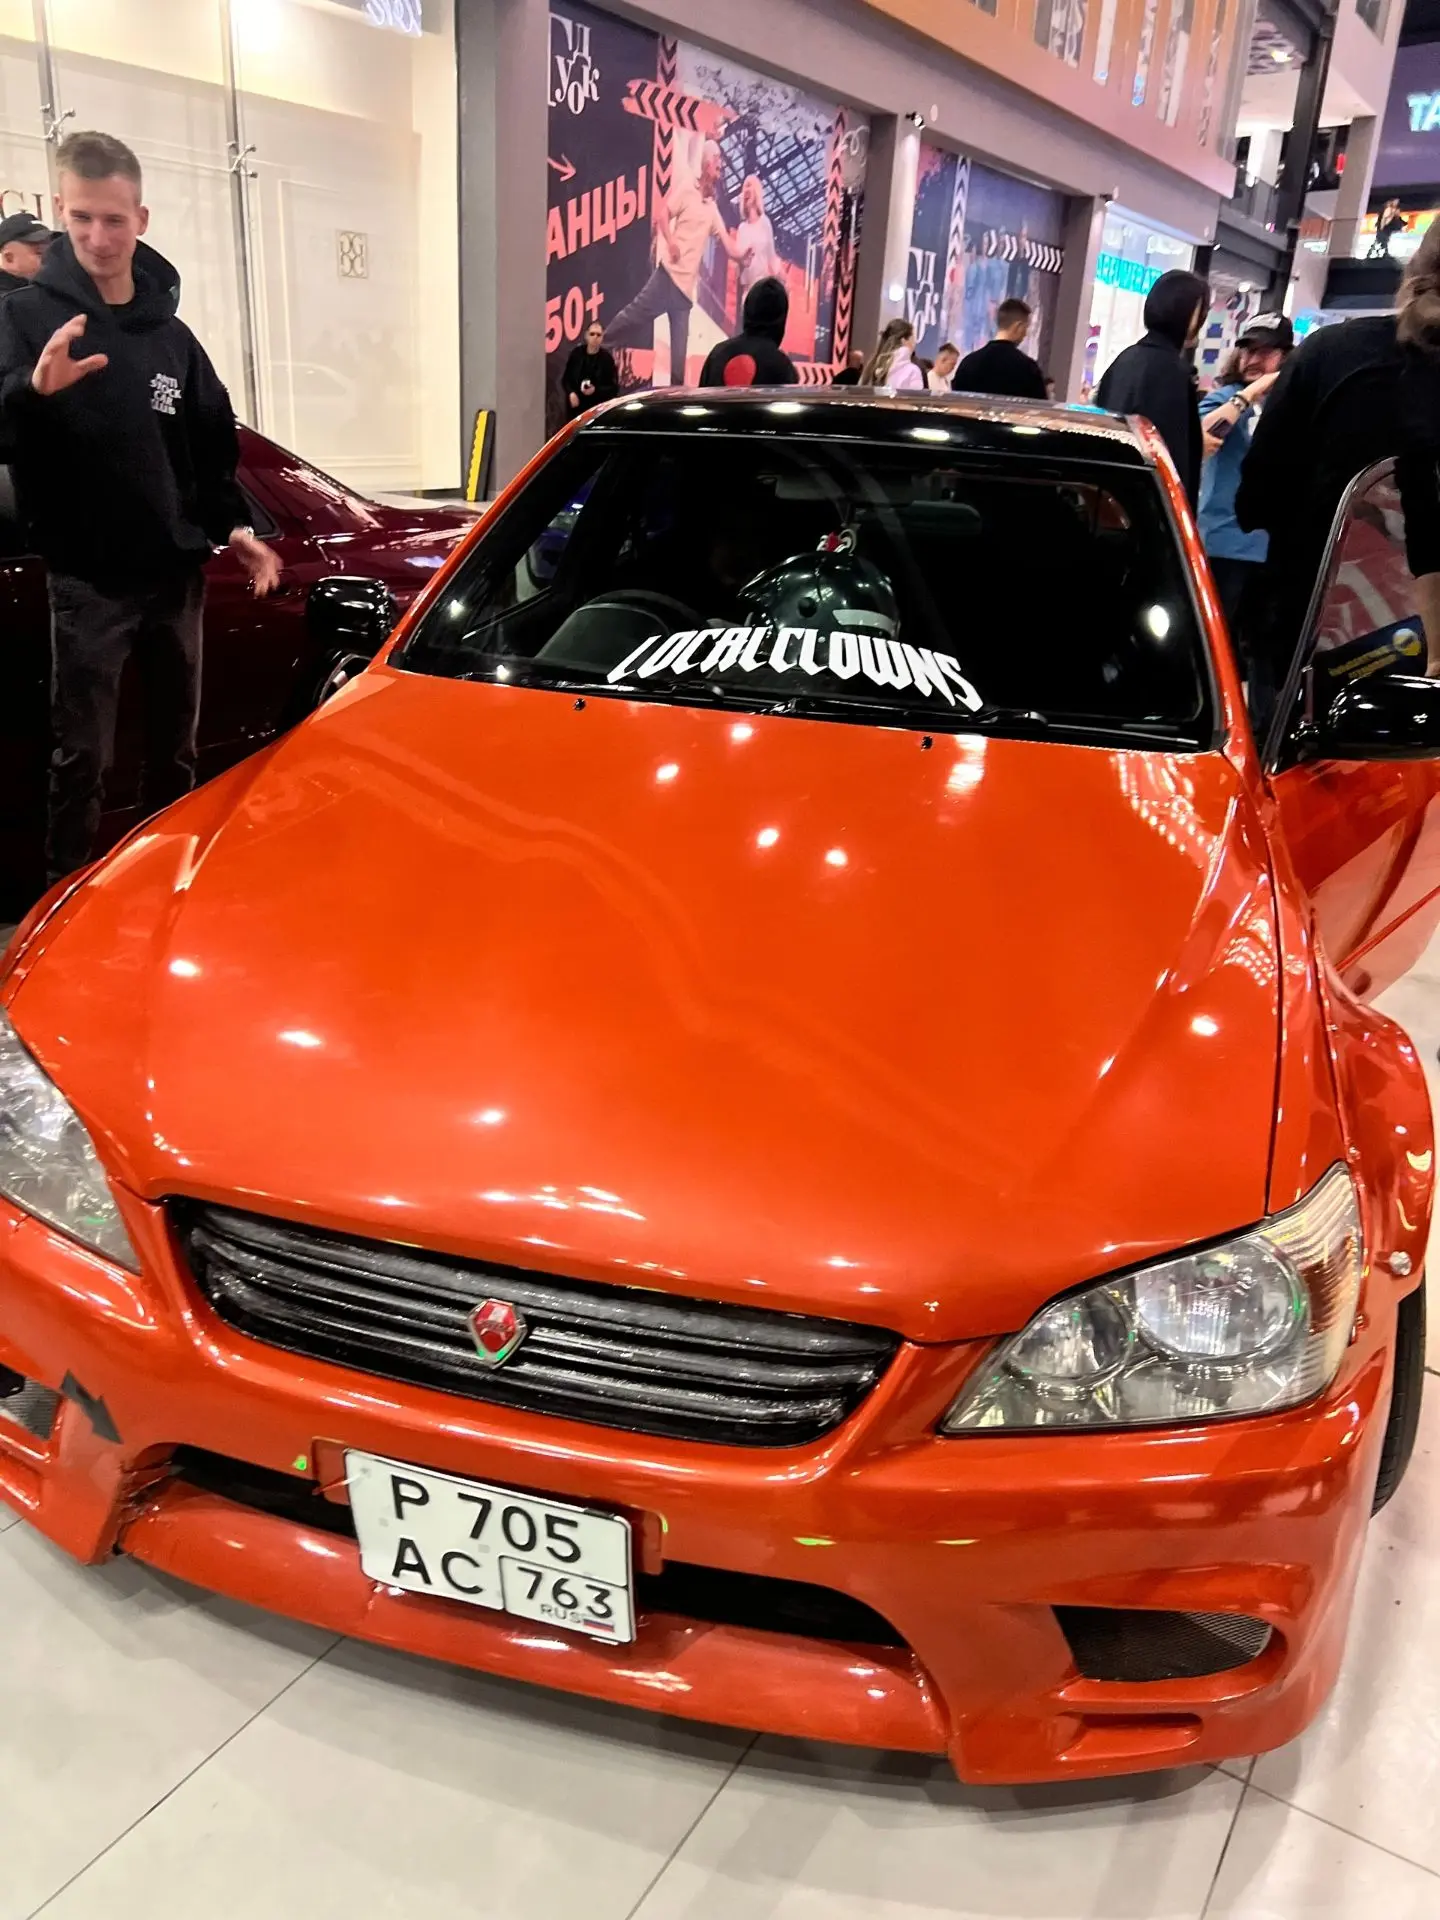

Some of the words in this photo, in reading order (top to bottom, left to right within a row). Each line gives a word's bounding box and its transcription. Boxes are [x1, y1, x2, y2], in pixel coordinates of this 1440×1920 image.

[545, 281, 605, 353] 50+
[457, 1491, 582, 1564] 705
[517, 1566, 613, 1619] 763
[540, 1603, 583, 1624] RUS
